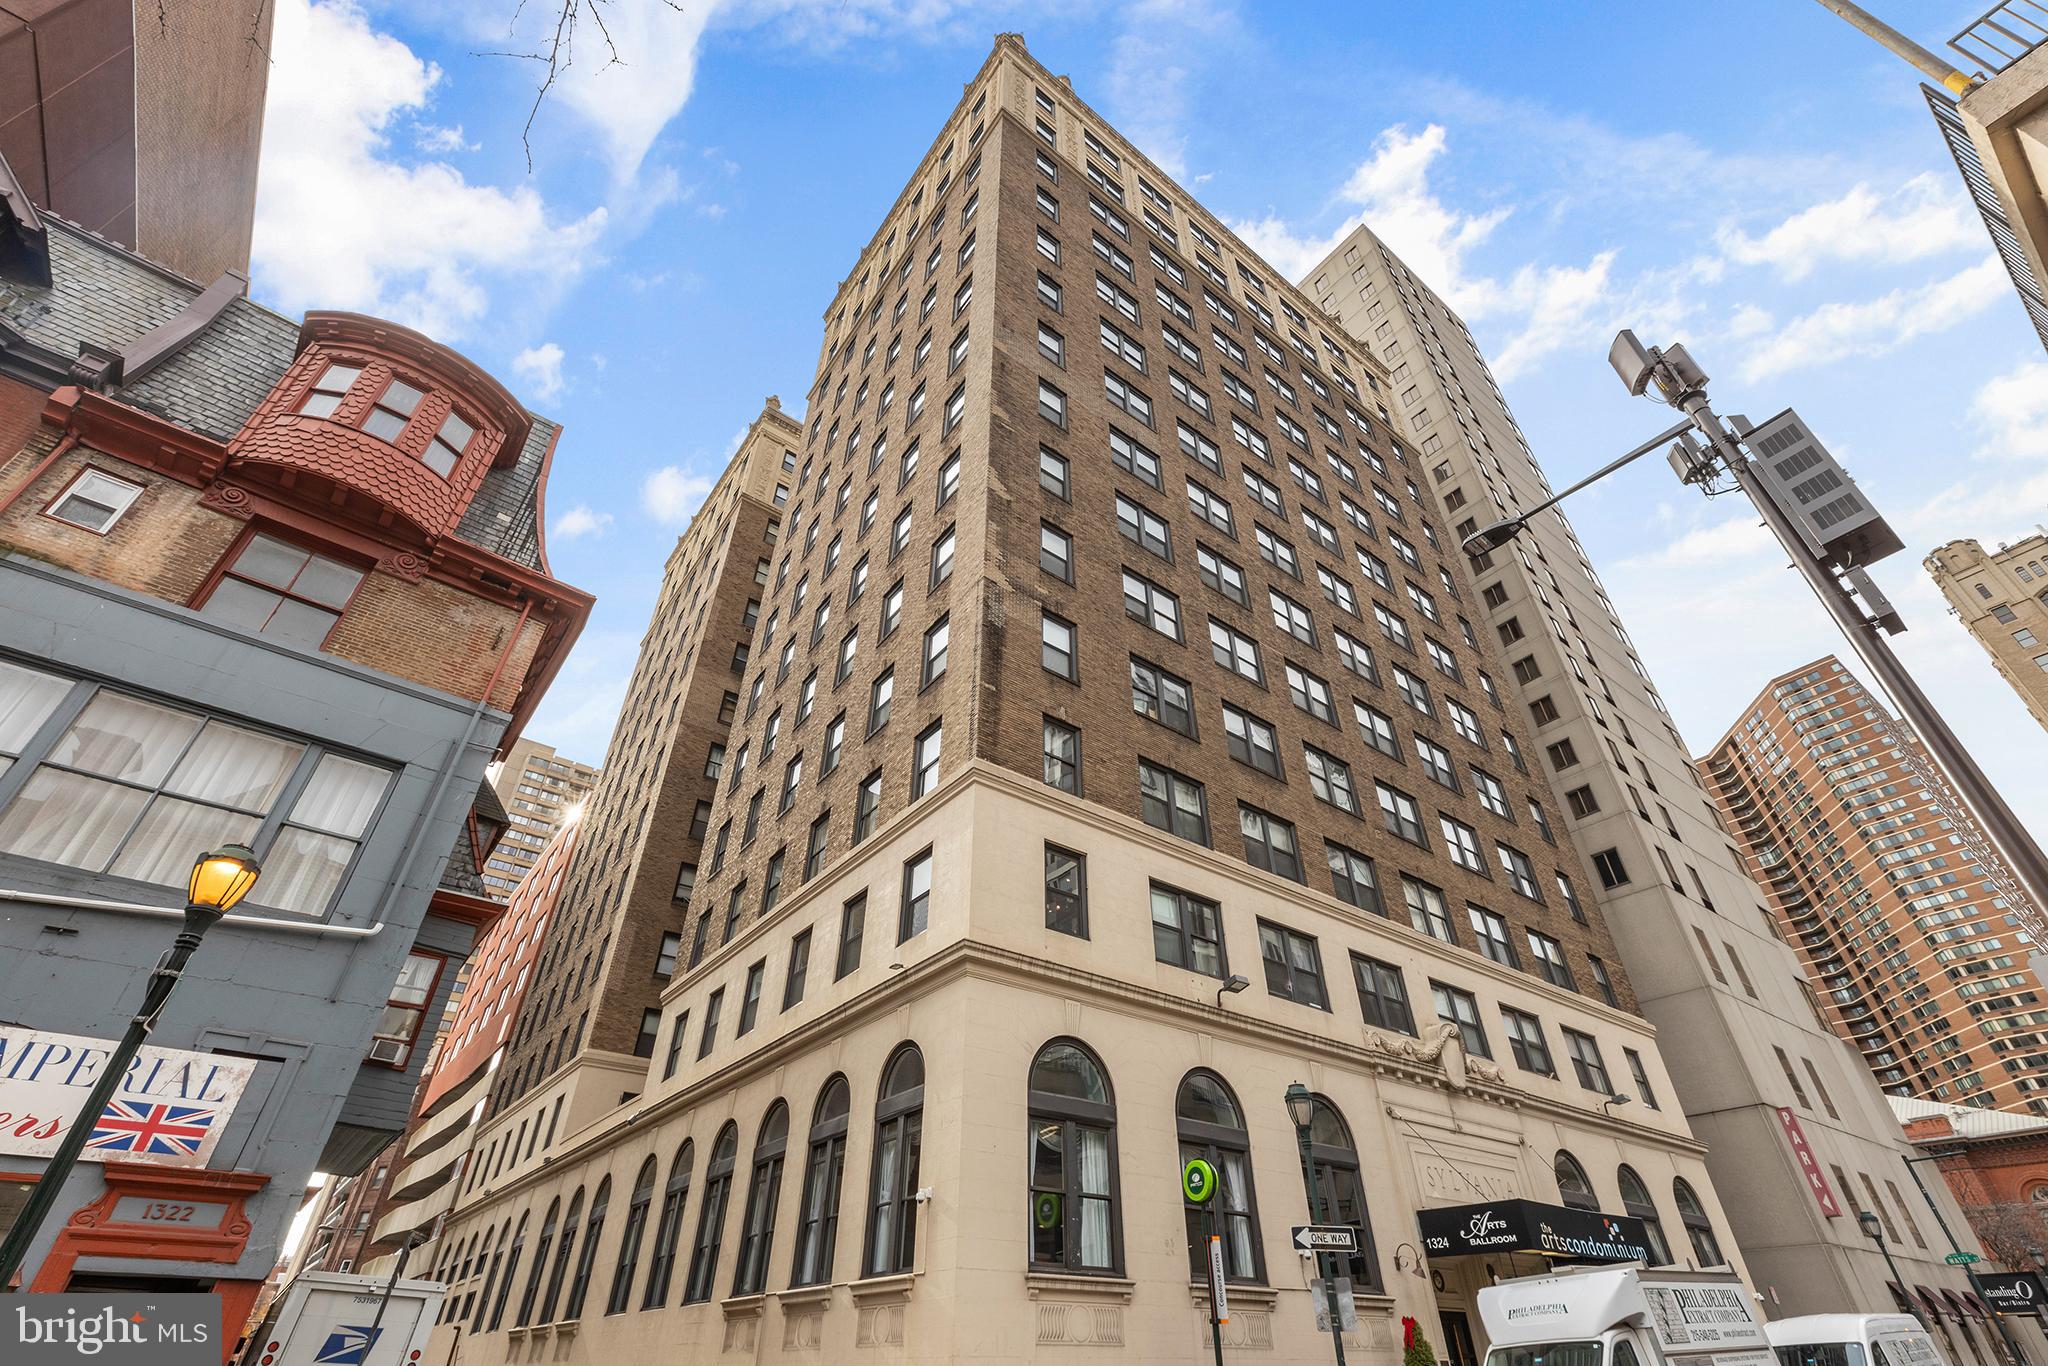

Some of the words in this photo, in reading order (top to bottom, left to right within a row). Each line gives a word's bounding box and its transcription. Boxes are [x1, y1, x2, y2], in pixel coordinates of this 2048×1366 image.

[1781, 1111, 1822, 1188] PARK
[142, 1203, 195, 1221] 1322
[1540, 1222, 1552, 1234] the
[1311, 1233, 1328, 1243] ONE
[1330, 1234, 1347, 1243] WAY
[1426, 1236, 1450, 1249] 1324
[1469, 1234, 1518, 1246] BALLROOM
[1508, 1303, 1568, 1320] PHILADELPHIA
[1672, 1288, 1752, 1324] PHILADELPHIA
